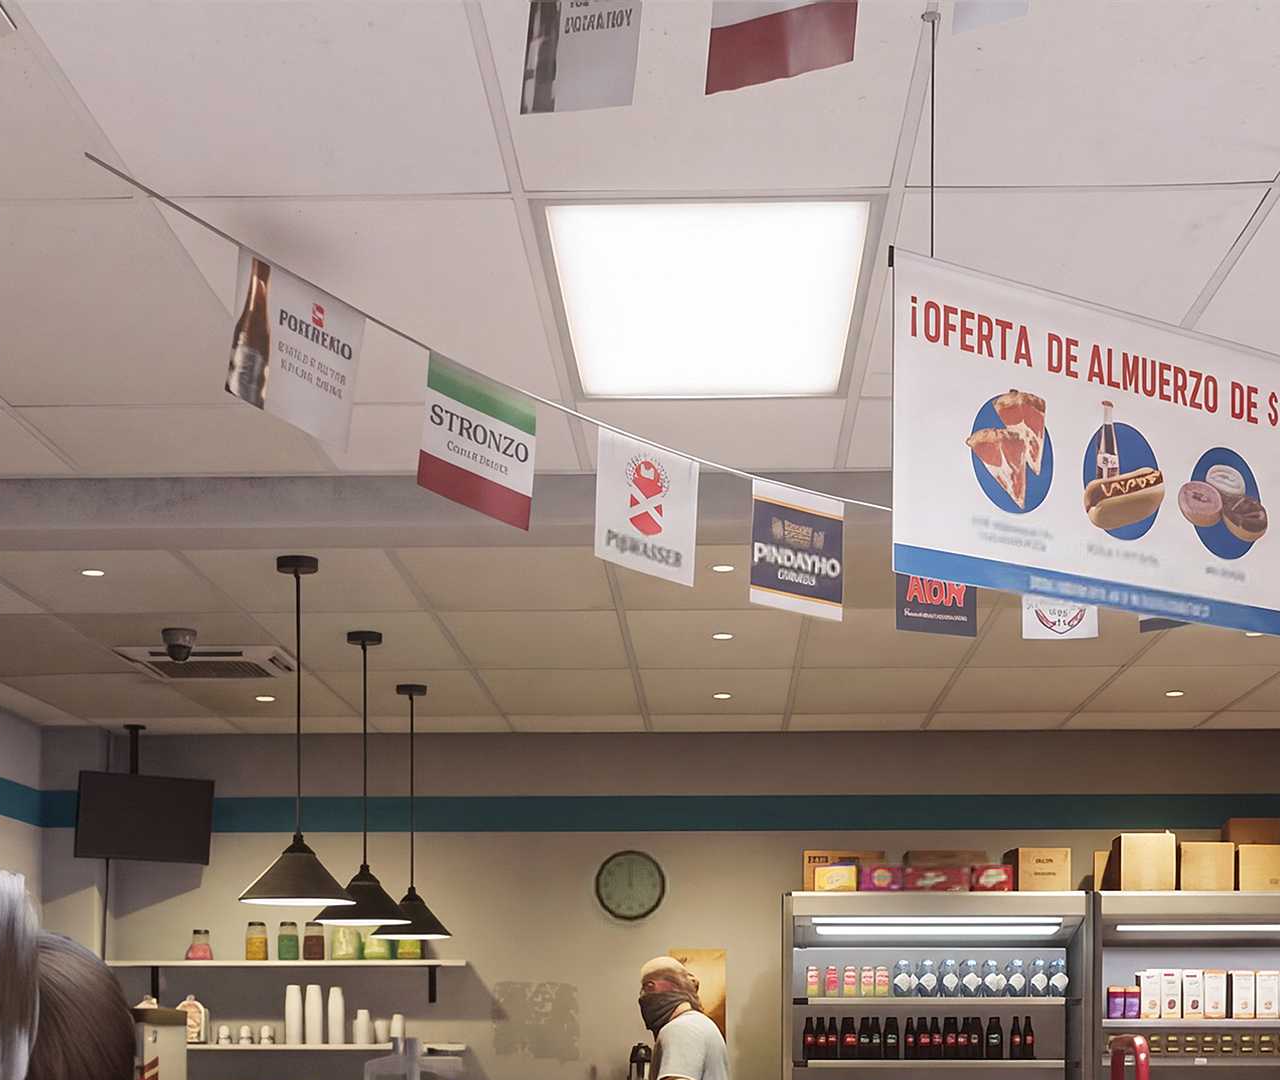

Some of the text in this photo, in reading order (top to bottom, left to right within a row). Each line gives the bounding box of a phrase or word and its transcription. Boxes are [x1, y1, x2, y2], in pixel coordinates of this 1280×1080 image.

[910, 296, 1033, 367] ¡OFERTA
[1047, 332, 1079, 380] DE
[1087, 344, 1219, 414] ALMUERZO
[1230, 381, 1259, 426] DE
[429, 403, 529, 463] STRONZO
